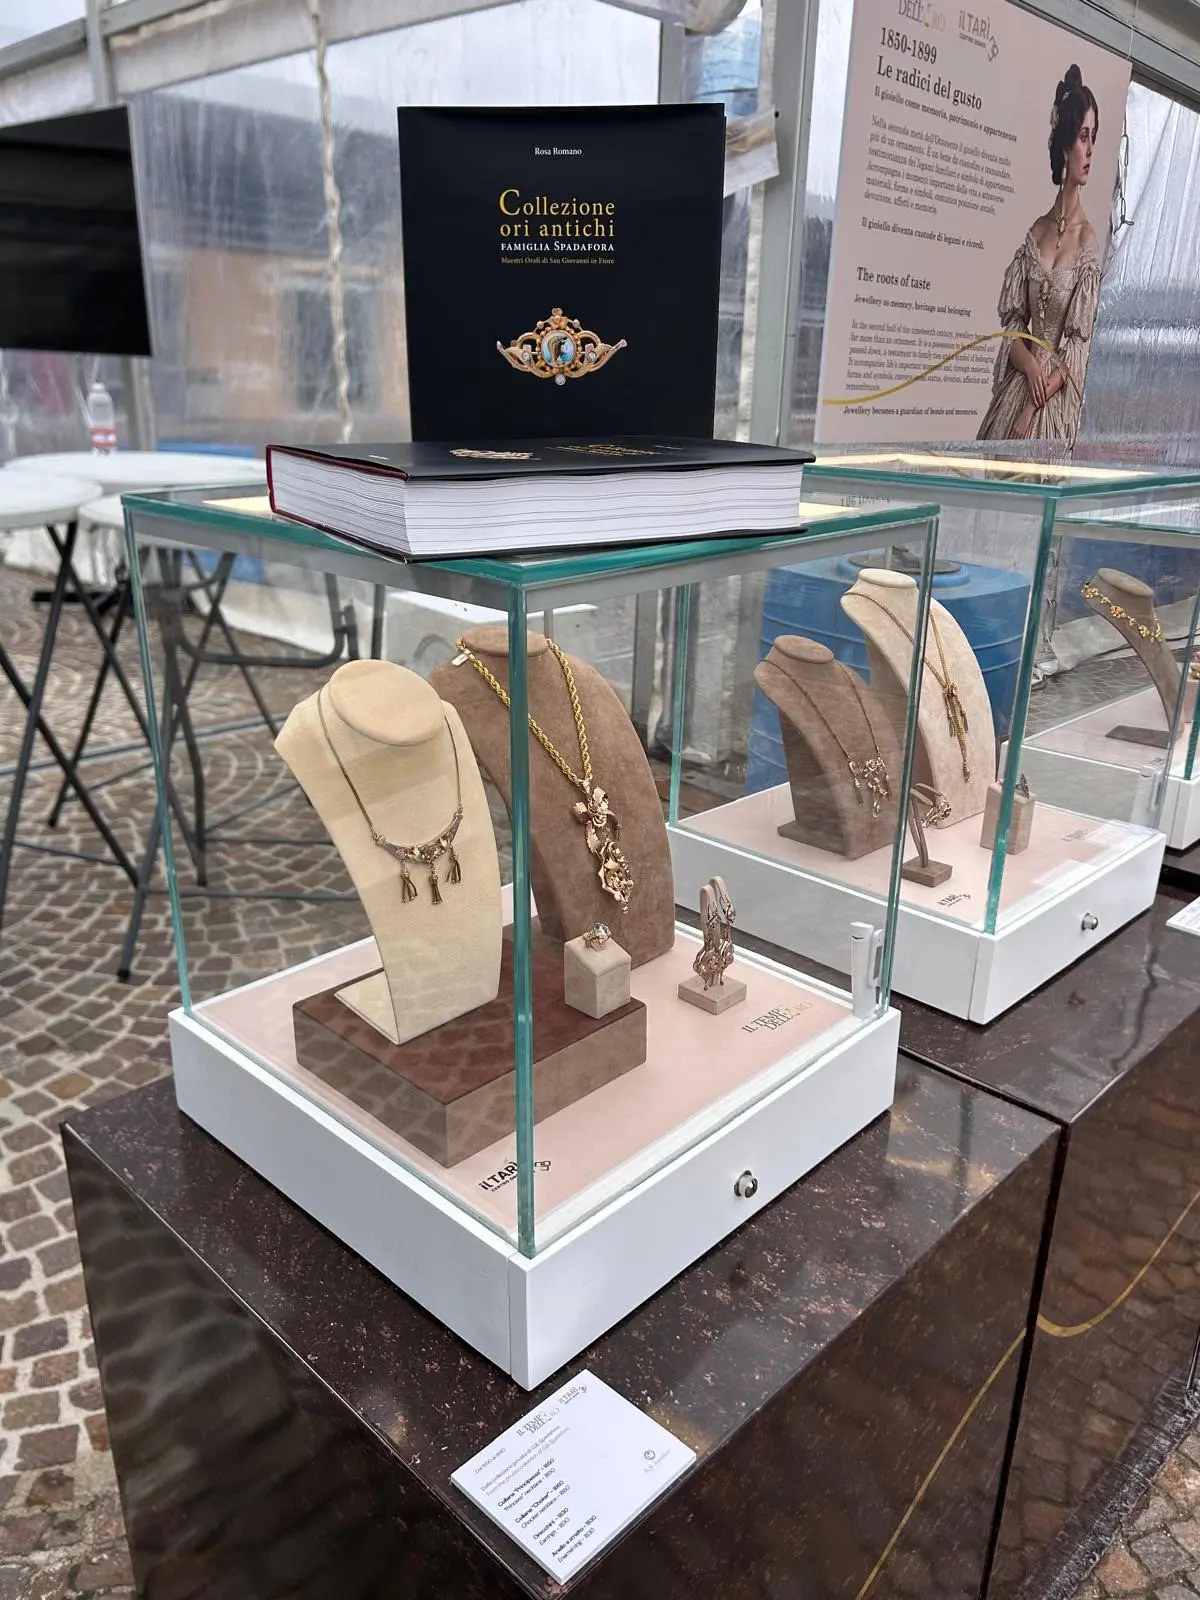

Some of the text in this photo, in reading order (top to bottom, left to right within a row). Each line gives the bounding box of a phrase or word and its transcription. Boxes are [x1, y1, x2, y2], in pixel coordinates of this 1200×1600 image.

[881, 27, 936, 63] 1850-1899
[876, 54, 981, 109] Le radici del gusto
[874, 85, 880, 96] Il
[880, 90, 903, 104] gioiello
[904, 99, 920, 109] come
[921, 104, 947, 119] memoria,
[948, 114, 978, 128] patrimonio
[983, 125, 1016, 141] appartenenza
[534, 147, 582, 155] Rosa Romano
[499, 189, 615, 216] Collezione
[500, 219, 615, 237] ori antichi
[861, 216, 867, 227] Il
[867, 219, 890, 231] gioiello
[891, 223, 913, 236] diventa
[914, 230, 935, 240] custode
[936, 231, 942, 241] di
[943, 233, 961, 245] legami
[965, 238, 984, 249] ricordi.
[501, 241, 614, 251] FAMIGLIA SPADAFORA
[856, 266, 930, 289] The roots of taste
[854, 294, 881, 306] Jewellery
[890, 300, 913, 310] memory,
[914, 301, 935, 312] heritage
[936, 304, 946, 313] and
[947, 305, 971, 317] belonging
[843, 405, 870, 415] Jewellery
[899, 406, 922, 416] guardian
[497, 1492, 515, 1506] Collana
[514, 1508, 532, 1523] Collana
